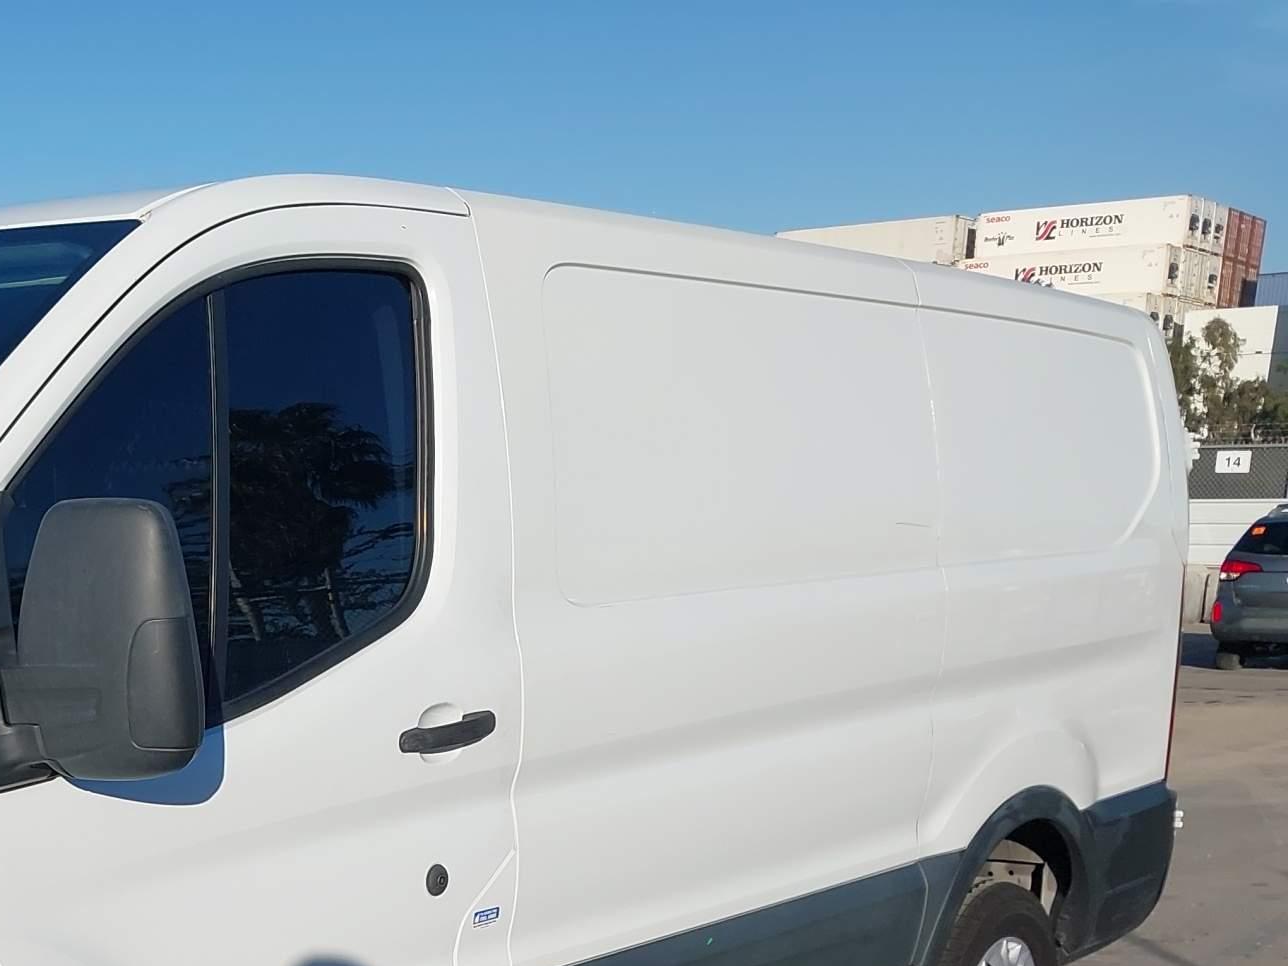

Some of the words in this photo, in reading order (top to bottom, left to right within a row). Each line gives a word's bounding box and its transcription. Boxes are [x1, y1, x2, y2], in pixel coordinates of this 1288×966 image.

[1060, 214, 1125, 229] HORIZON
[1058, 226, 1114, 237] LINES
[964, 261, 989, 270] seaco
[1039, 262, 1104, 276] HORIZON
[1225, 456, 1241, 468] 14
